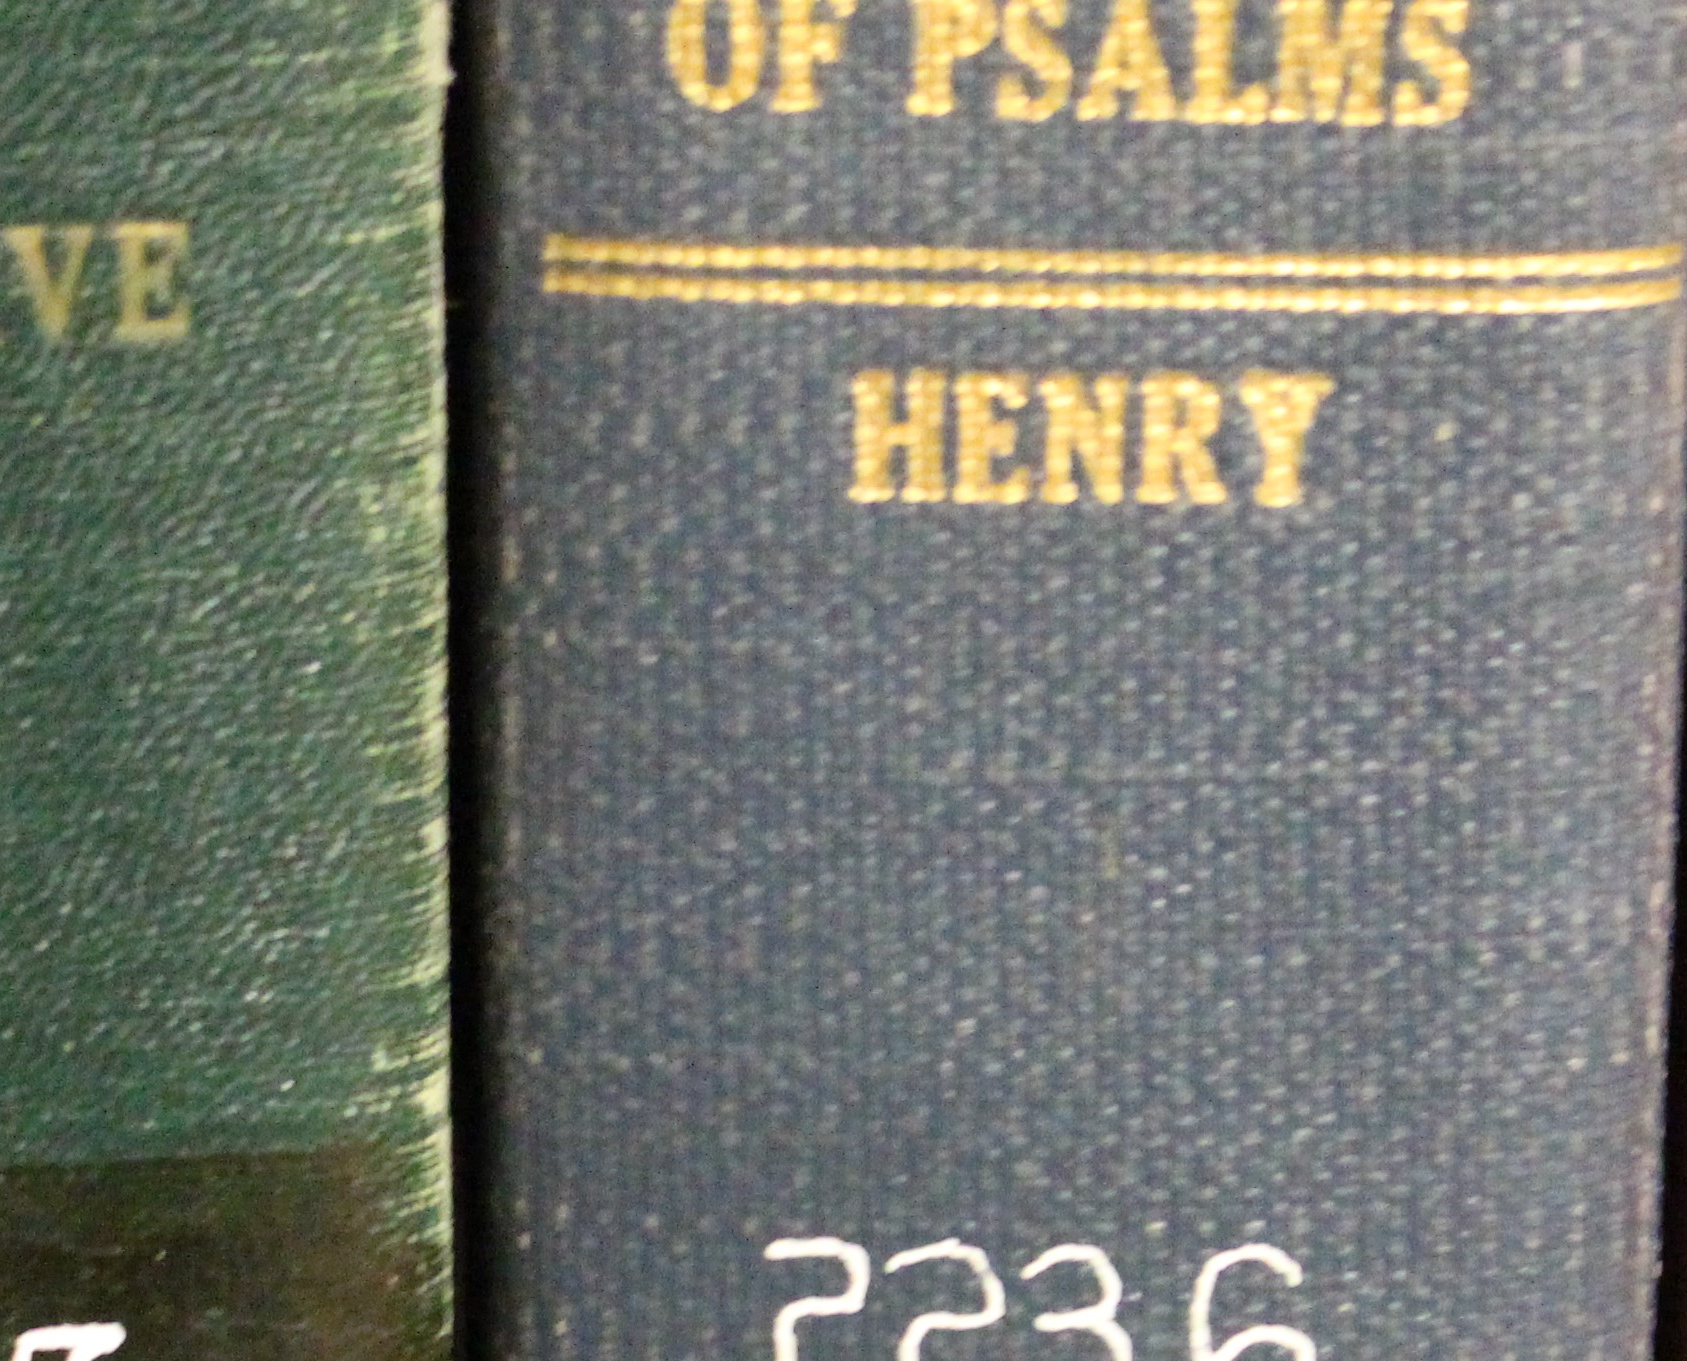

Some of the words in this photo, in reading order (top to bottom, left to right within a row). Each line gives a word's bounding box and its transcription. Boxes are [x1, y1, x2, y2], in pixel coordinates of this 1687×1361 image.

[664, 0, 855, 114] OF
[905, 0, 1472, 128] PSALMS
[847, 369, 1336, 508] HENRY
